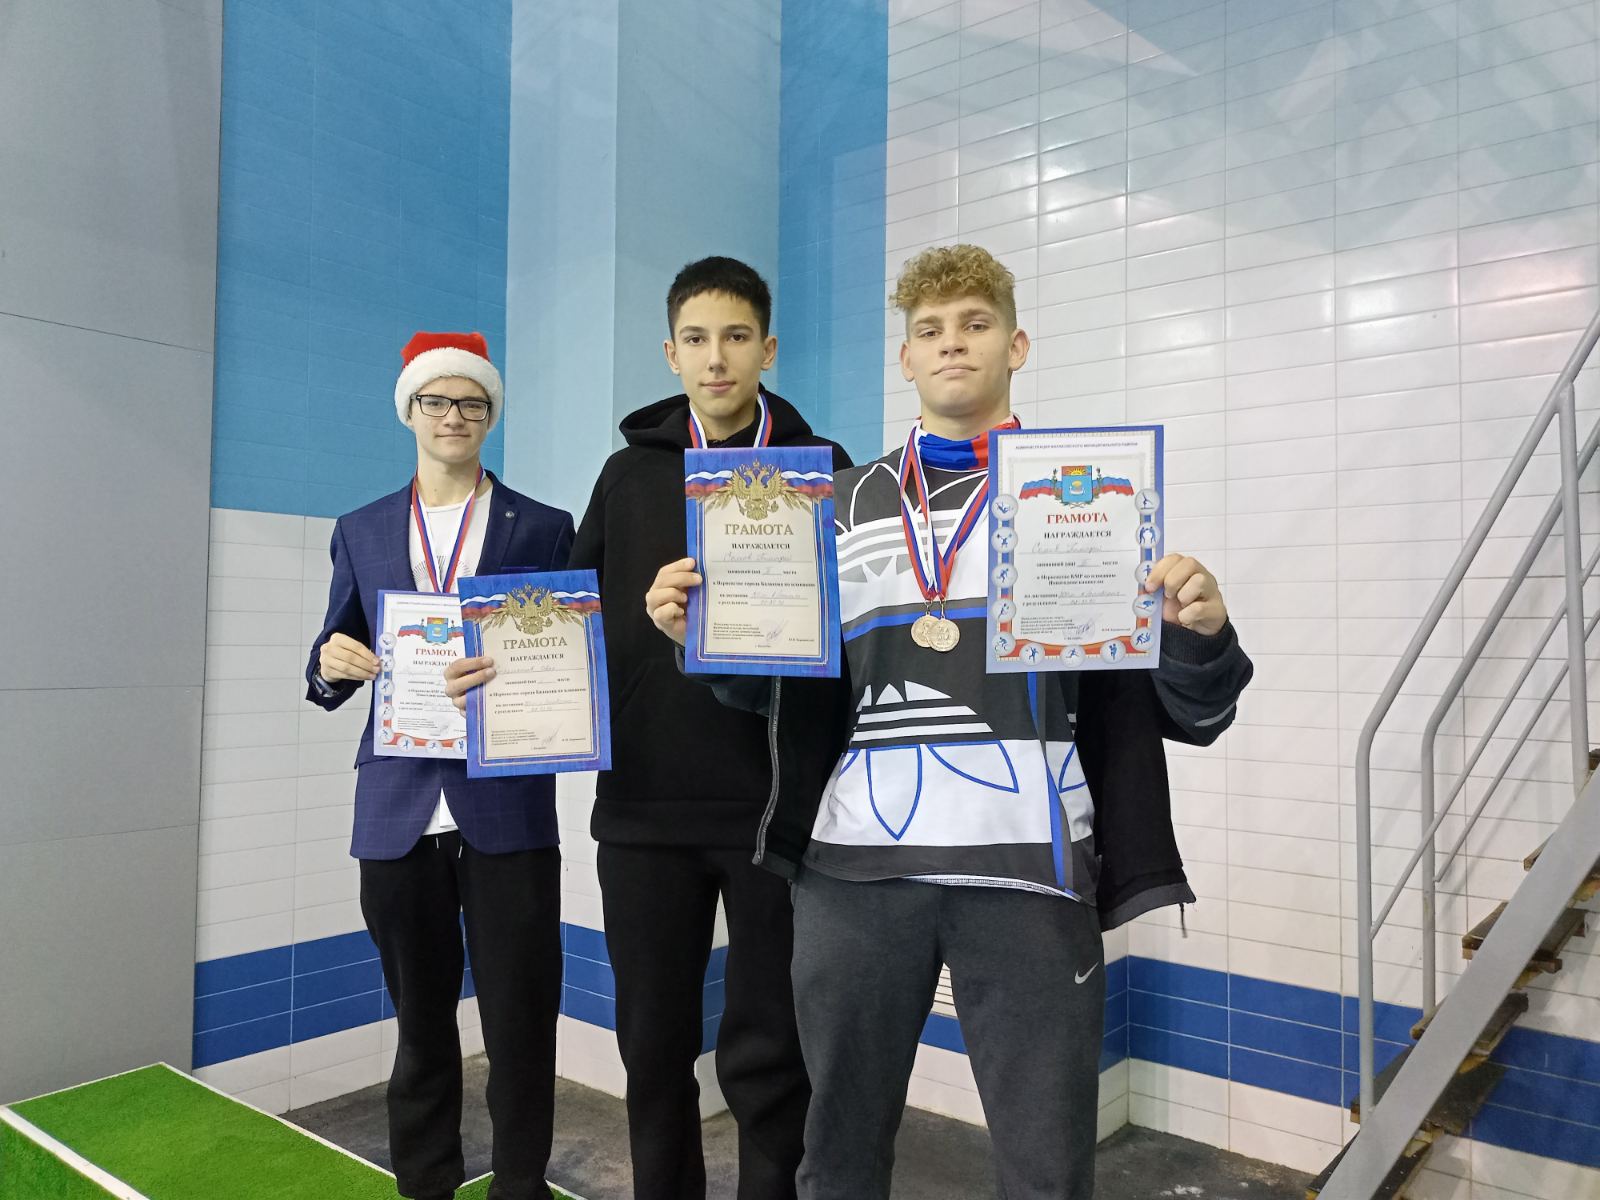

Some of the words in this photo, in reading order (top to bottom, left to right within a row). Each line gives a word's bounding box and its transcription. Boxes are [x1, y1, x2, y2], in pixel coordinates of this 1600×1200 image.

[1047, 512, 1108, 524] ГРАМОТА
[724, 523, 794, 536] ГРАМОТА
[1044, 530, 1111, 540] НАГРАЖДАЕТСЯ
[503, 636, 568, 650] ГРАМОТА
[415, 648, 458, 657] ГРАМОТА
[510, 653, 564, 662] НАГРАЖДАЕТСЯ
